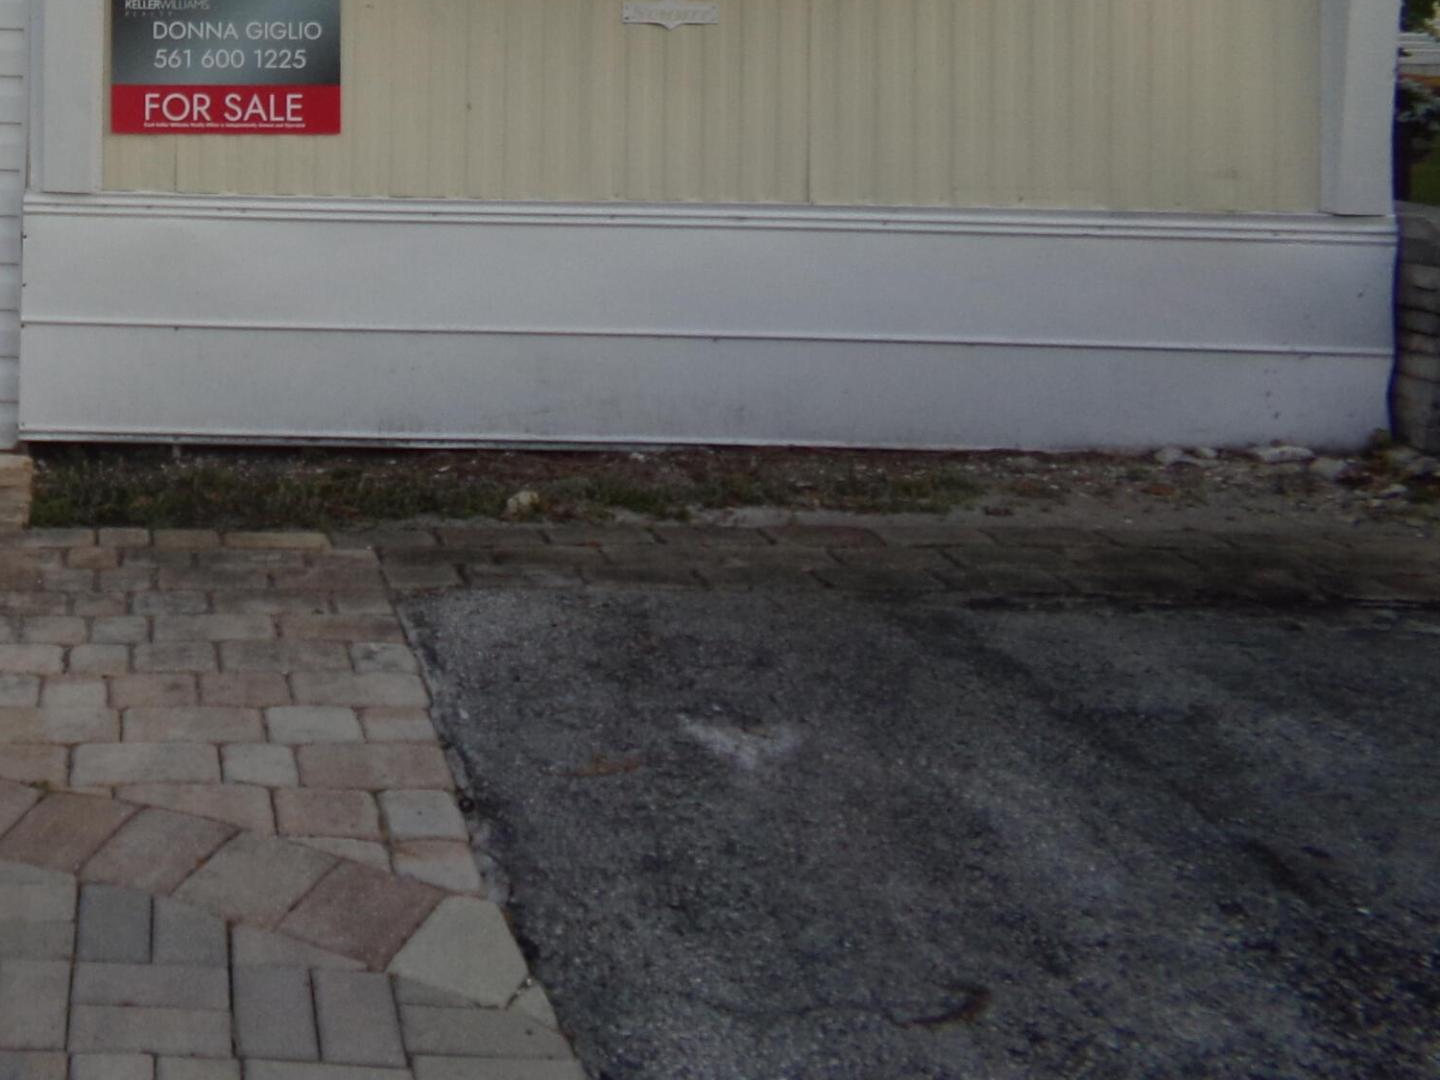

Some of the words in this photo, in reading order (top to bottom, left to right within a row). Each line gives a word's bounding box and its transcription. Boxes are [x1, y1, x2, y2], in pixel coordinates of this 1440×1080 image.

[153, 21, 239, 41] DONNA
[246, 22, 323, 41] GIGLIO
[153, 49, 191, 69] 561
[200, 49, 245, 69] 600
[253, 49, 307, 69] 1225
[144, 93, 211, 122] FOR
[223, 93, 304, 122] SALE
